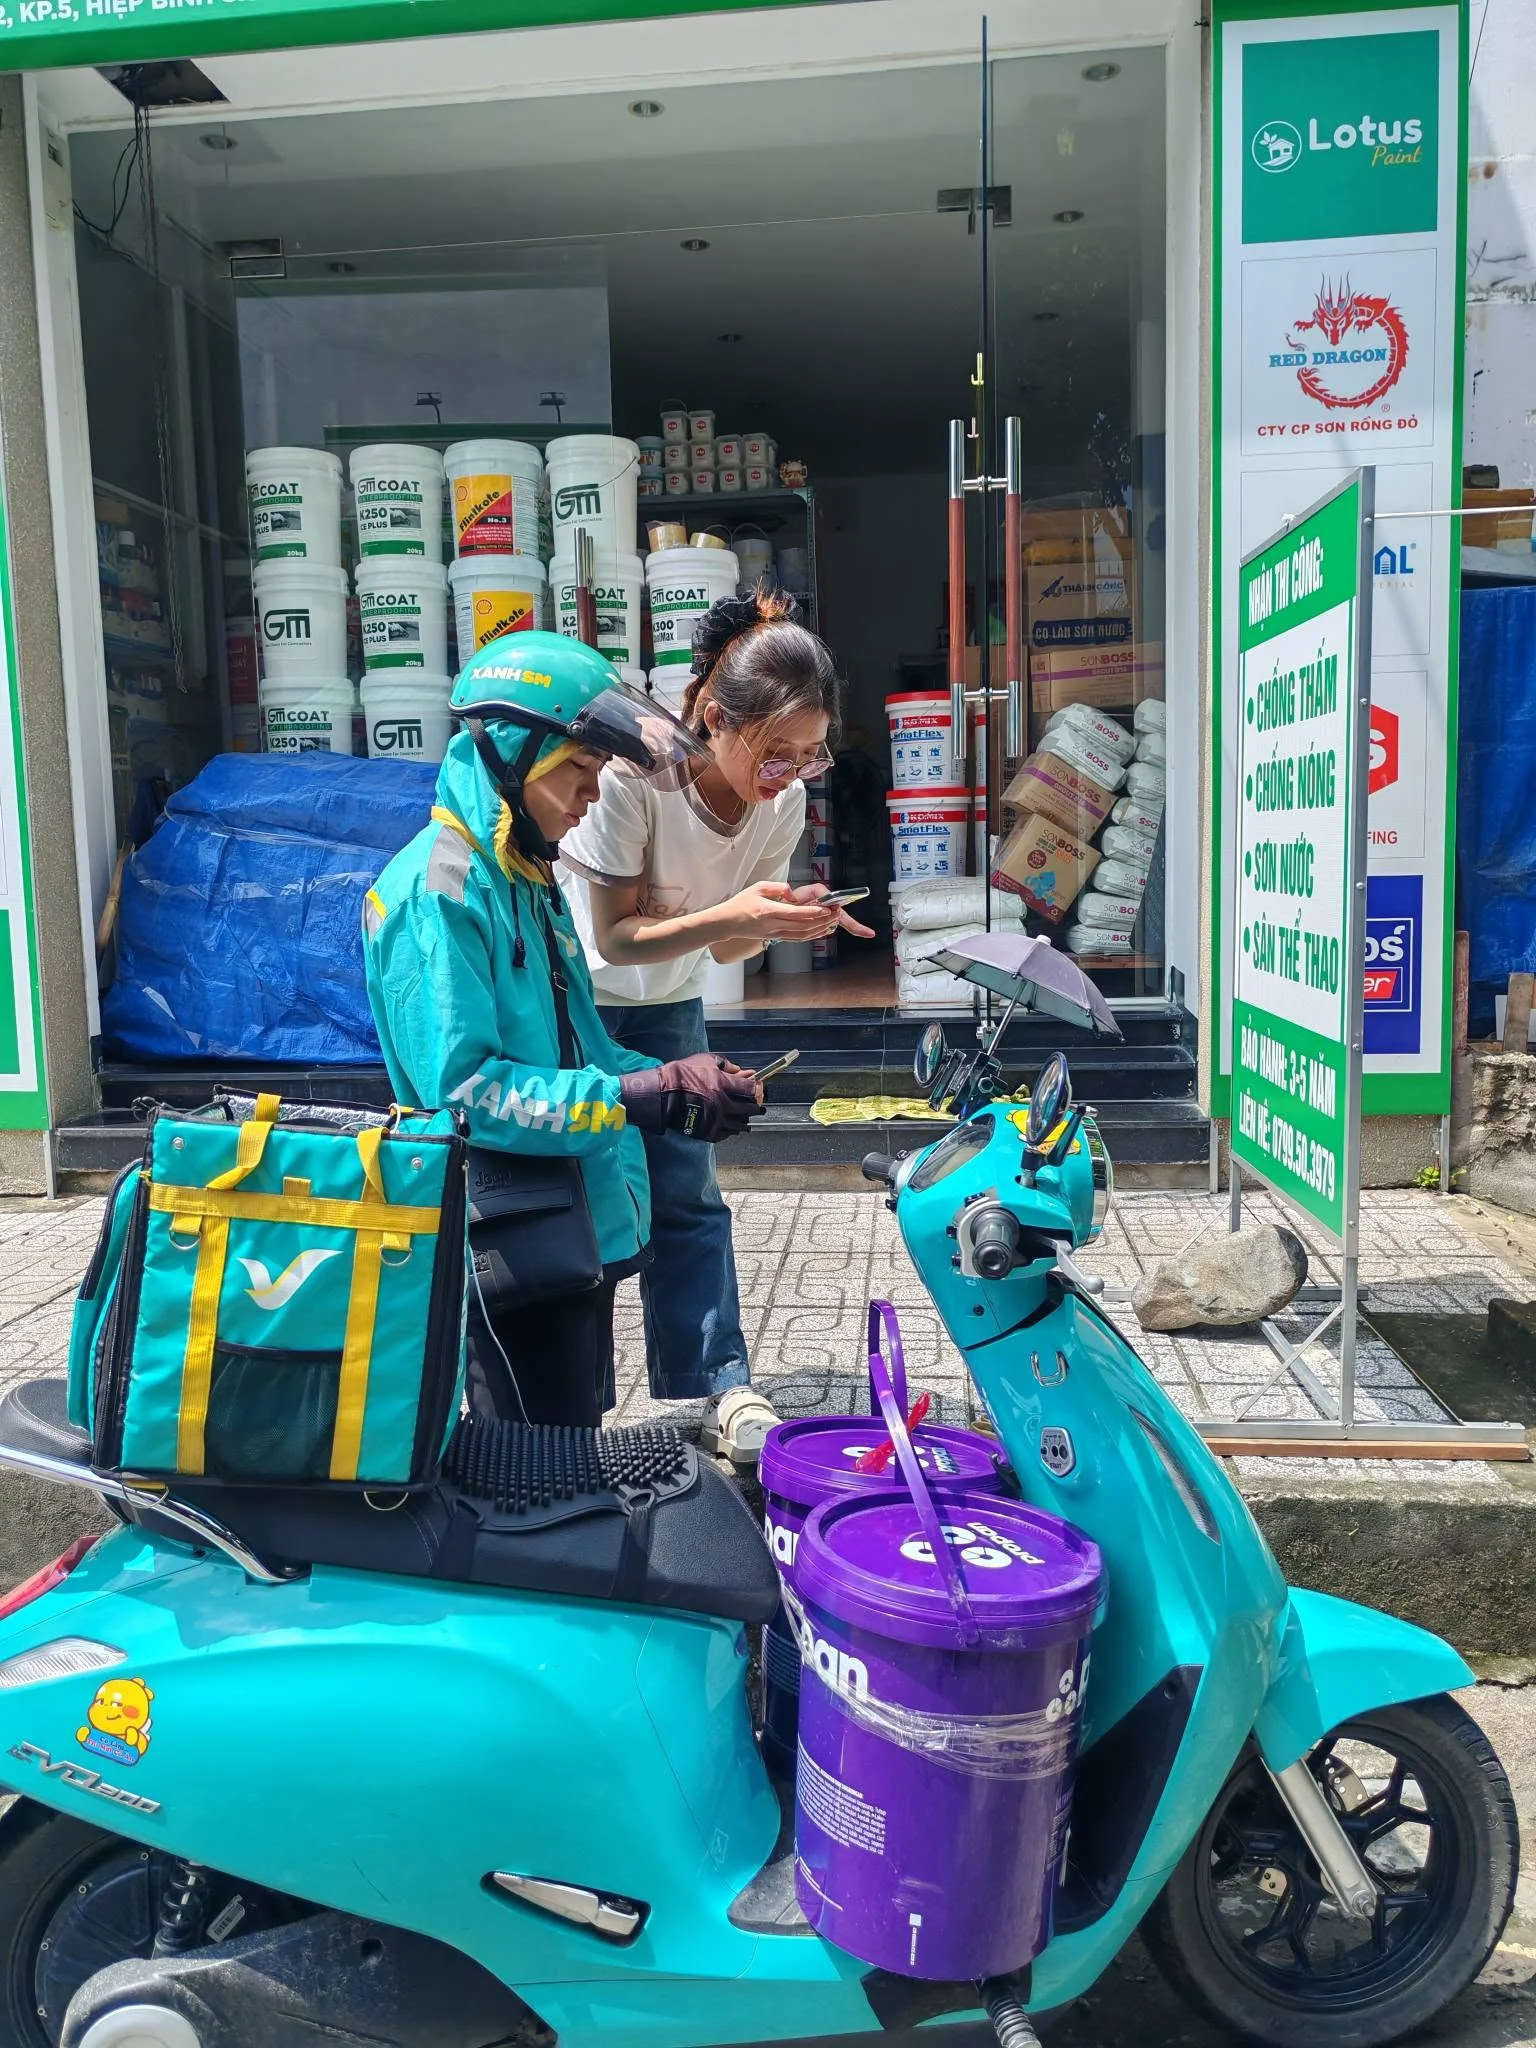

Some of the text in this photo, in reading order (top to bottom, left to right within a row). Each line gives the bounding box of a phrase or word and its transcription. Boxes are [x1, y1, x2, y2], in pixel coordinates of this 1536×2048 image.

[20, 0, 79, 24] KP.5,
[1309, 115, 1423, 150] Lotus
[1372, 145, 1423, 167] Paint
[1269, 348, 1387, 368] RED DRAGON
[1258, 414, 1419, 437] CTY CP SƠN RỒNG ĐỎ
[260, 483, 300, 496] COAT
[358, 477, 420, 495] GM COAT
[459, 490, 500, 532] Flintkote
[555, 484, 601, 520] GM
[360, 508, 388, 521] K250
[368, 521, 388, 530] PLUS
[487, 516, 507, 524] No.3
[406, 548, 423, 556] 20kg
[596, 588, 626, 600] OAT
[1248, 536, 1324, 631] NHẬN THI CÔNG:
[377, 594, 418, 606] COAT
[666, 589, 706, 601] COAT
[264, 608, 311, 641] GM
[363, 622, 386, 634] K250
[479, 607, 526, 646] Flintkote
[369, 635, 387, 643] PLUS
[1080, 652, 1136, 667] SONBOSS
[470, 667, 552, 688] XANH SM
[1257, 637, 1337, 733] CHỐNG THẤM
[268, 708, 329, 723] GM COAT
[270, 737, 297, 748] K250
[373, 719, 423, 750] GM
[1255, 741, 1336, 812] CHỐNG NÓNG
[898, 825, 948, 834] SmatFlex
[1042, 829, 1086, 860] SONBOSS
[1254, 832, 1314, 898] SƠN NƯỚC
[1253, 907, 1339, 995] SÂN THỂ THAO
[1241, 1013, 1336, 1119] BẢO HÀNH: 3-5 NĂM
[568, 1100, 627, 1134] SM
[1239, 1088, 1335, 1202] LIÊN HỆ: 0799.50.3979
